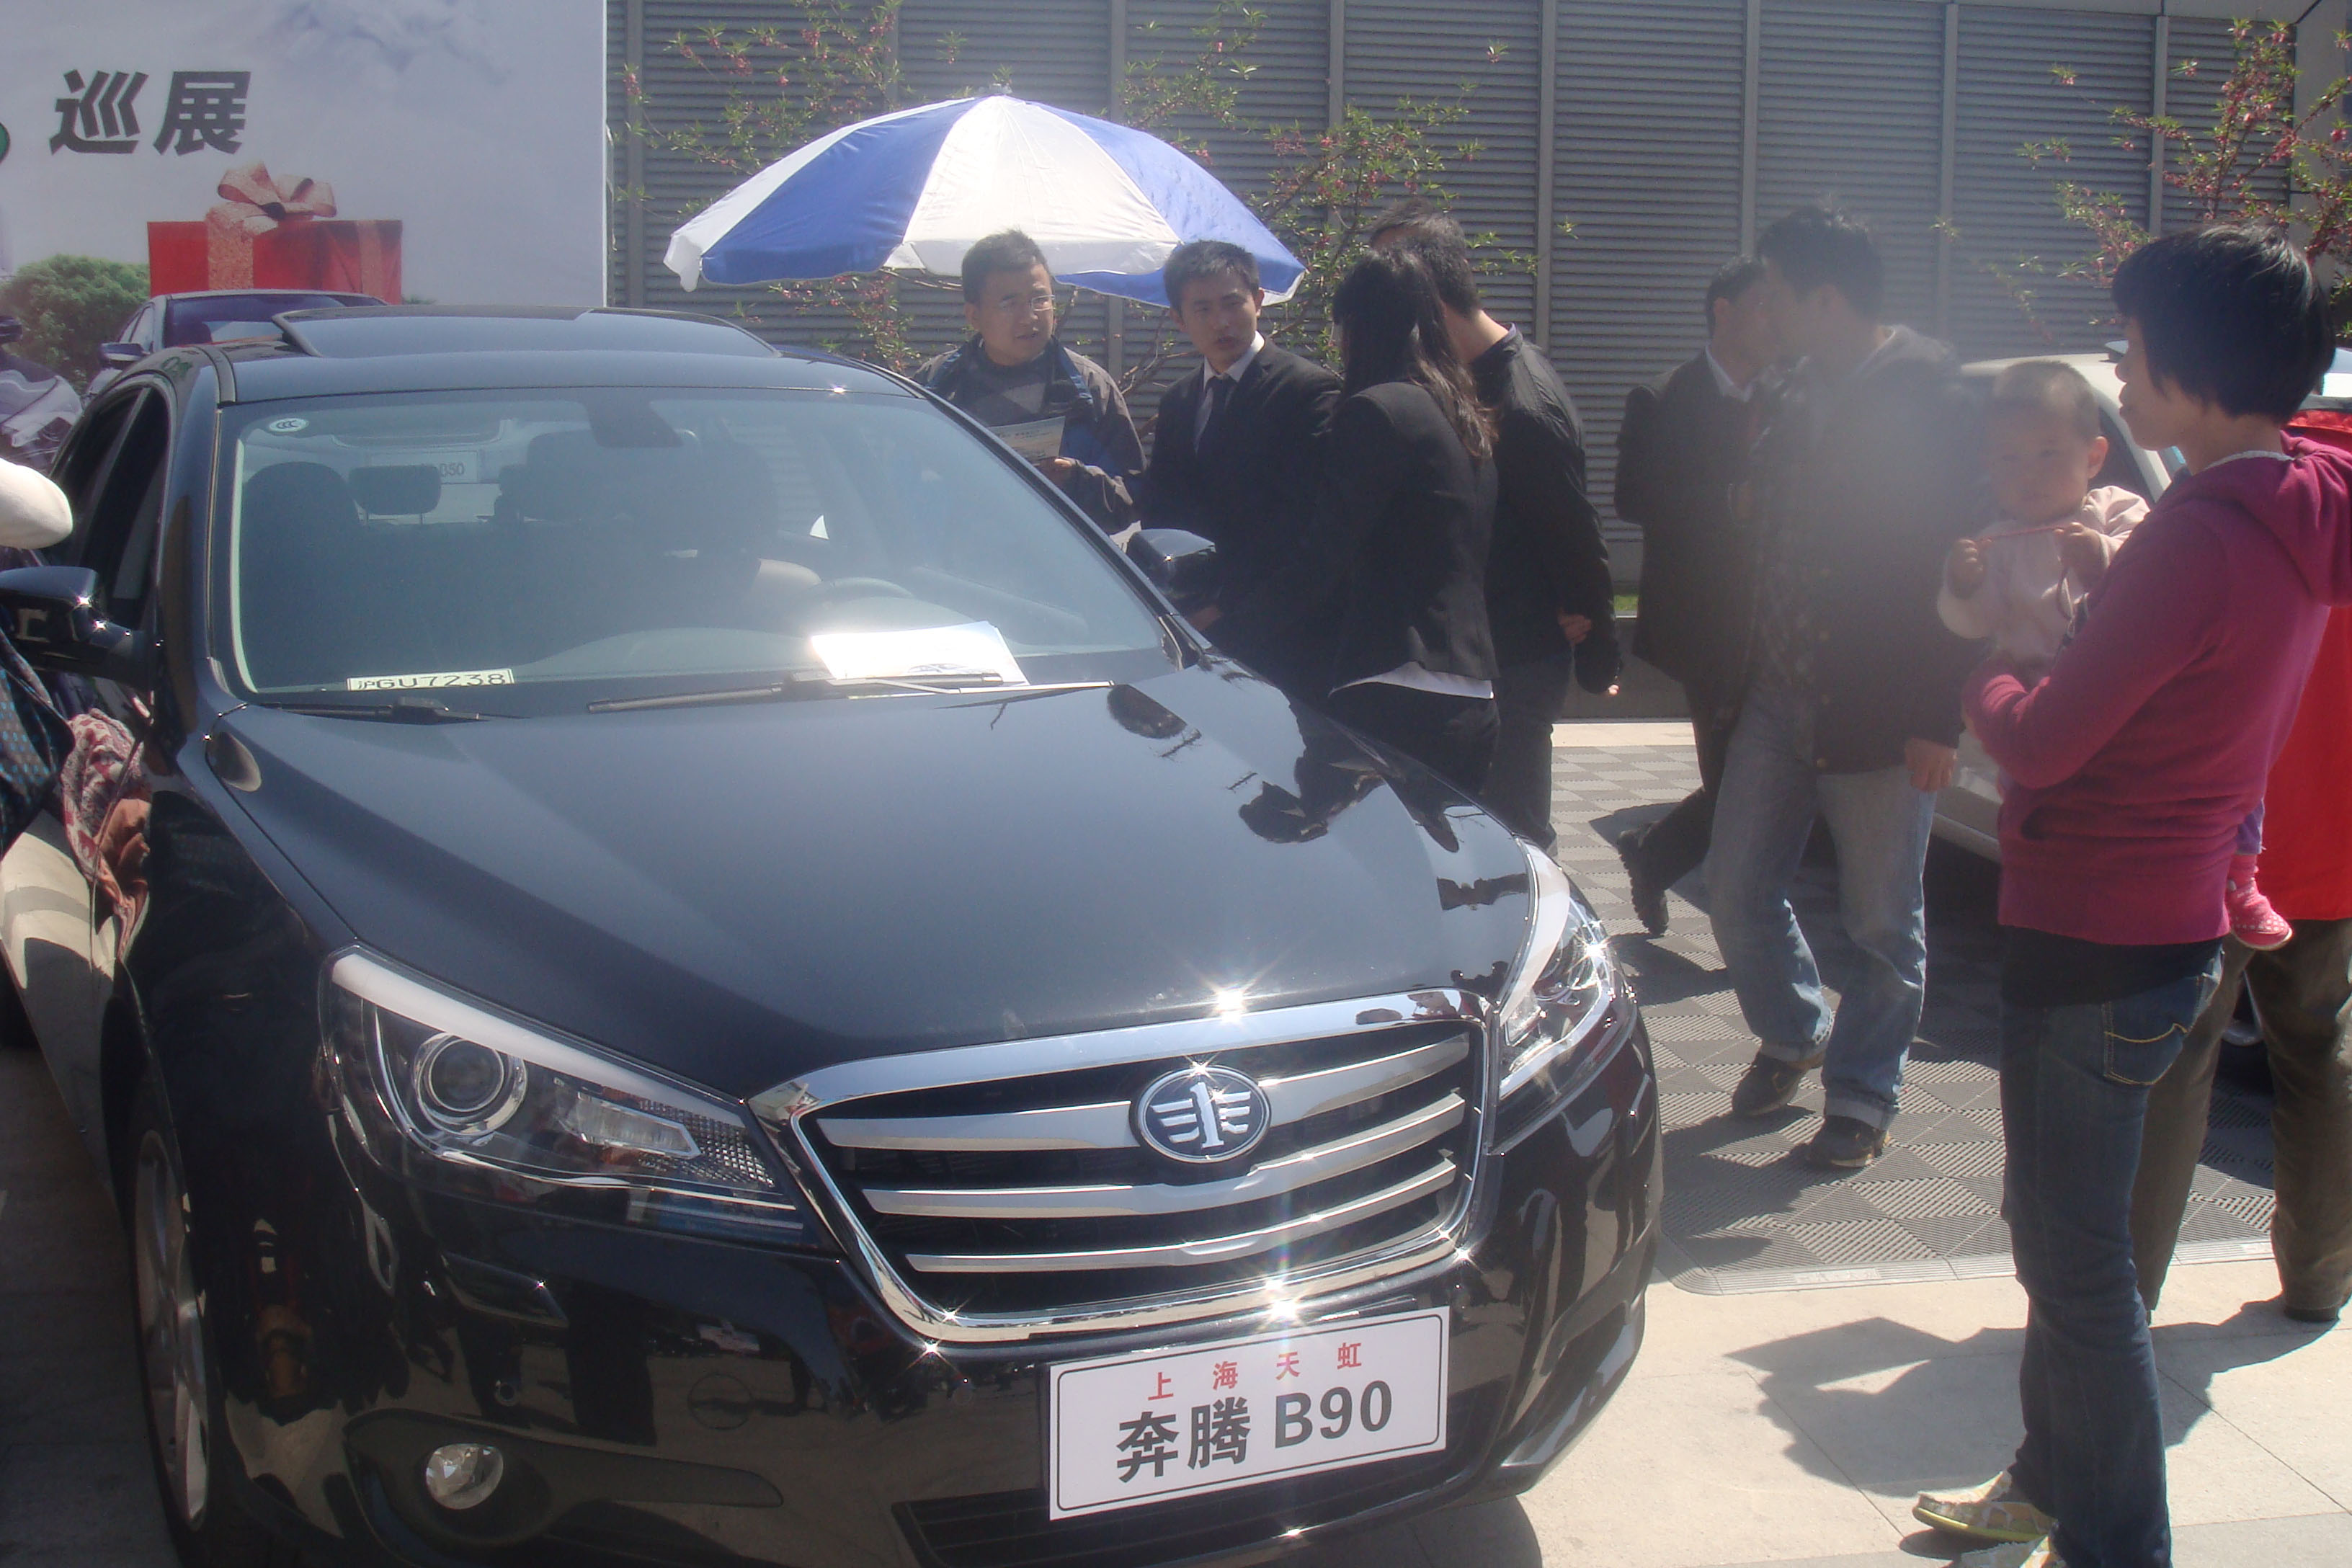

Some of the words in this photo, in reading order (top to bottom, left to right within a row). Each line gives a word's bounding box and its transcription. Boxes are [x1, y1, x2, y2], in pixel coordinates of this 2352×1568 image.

[49, 69, 251, 156] 巡展
[358, 673, 506, 690] 沪GU7238
[1147, 1342, 1362, 1402] 上海天虹
[1116, 1396, 1251, 1483] 奔腾
[1274, 1381, 1392, 1448] B90
